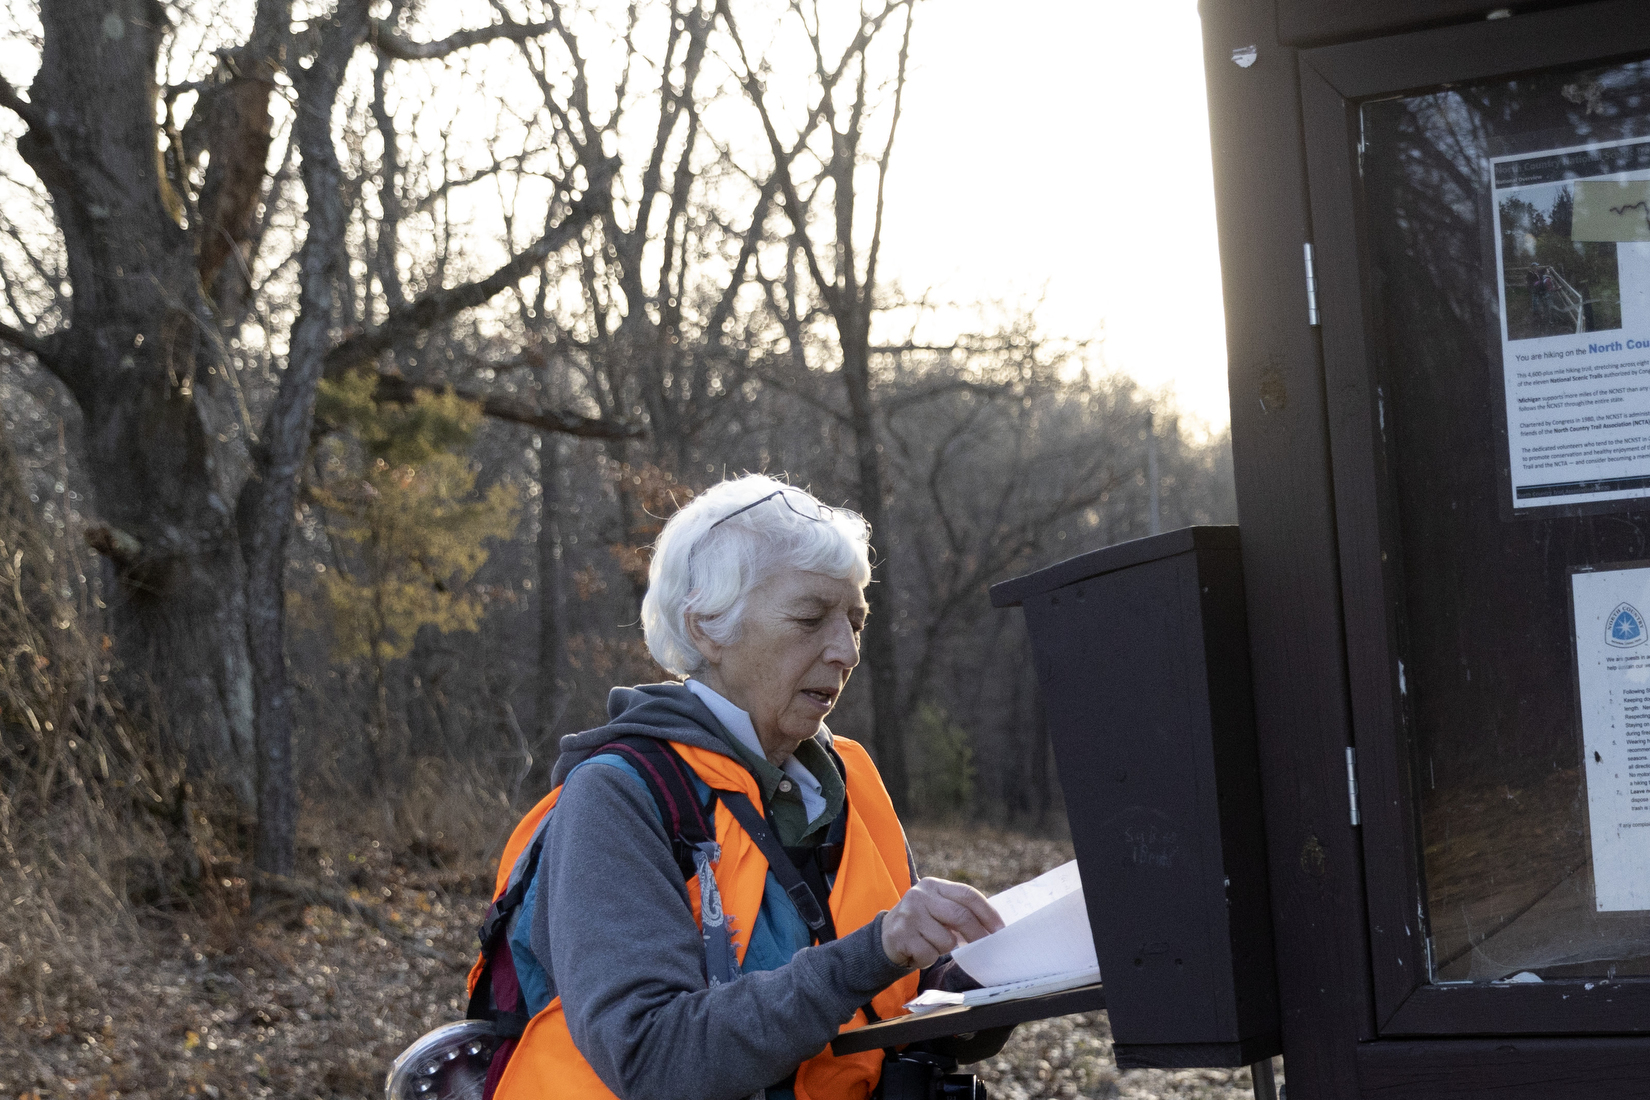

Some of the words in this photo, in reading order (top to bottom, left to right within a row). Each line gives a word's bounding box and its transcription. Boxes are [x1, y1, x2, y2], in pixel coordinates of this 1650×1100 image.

[1515, 353, 1529, 361] You
[1530, 352, 1542, 360] are
[1543, 349, 1563, 360] hiking
[1564, 348, 1574, 356] on
[1575, 347, 1586, 355] the
[1588, 340, 1622, 353] North
[1565, 366, 1580, 374] hiking
[1636, 359, 1649, 367] eight
[1606, 608, 1622, 630] NORTH
[1621, 605, 1644, 629] COUNTRY
